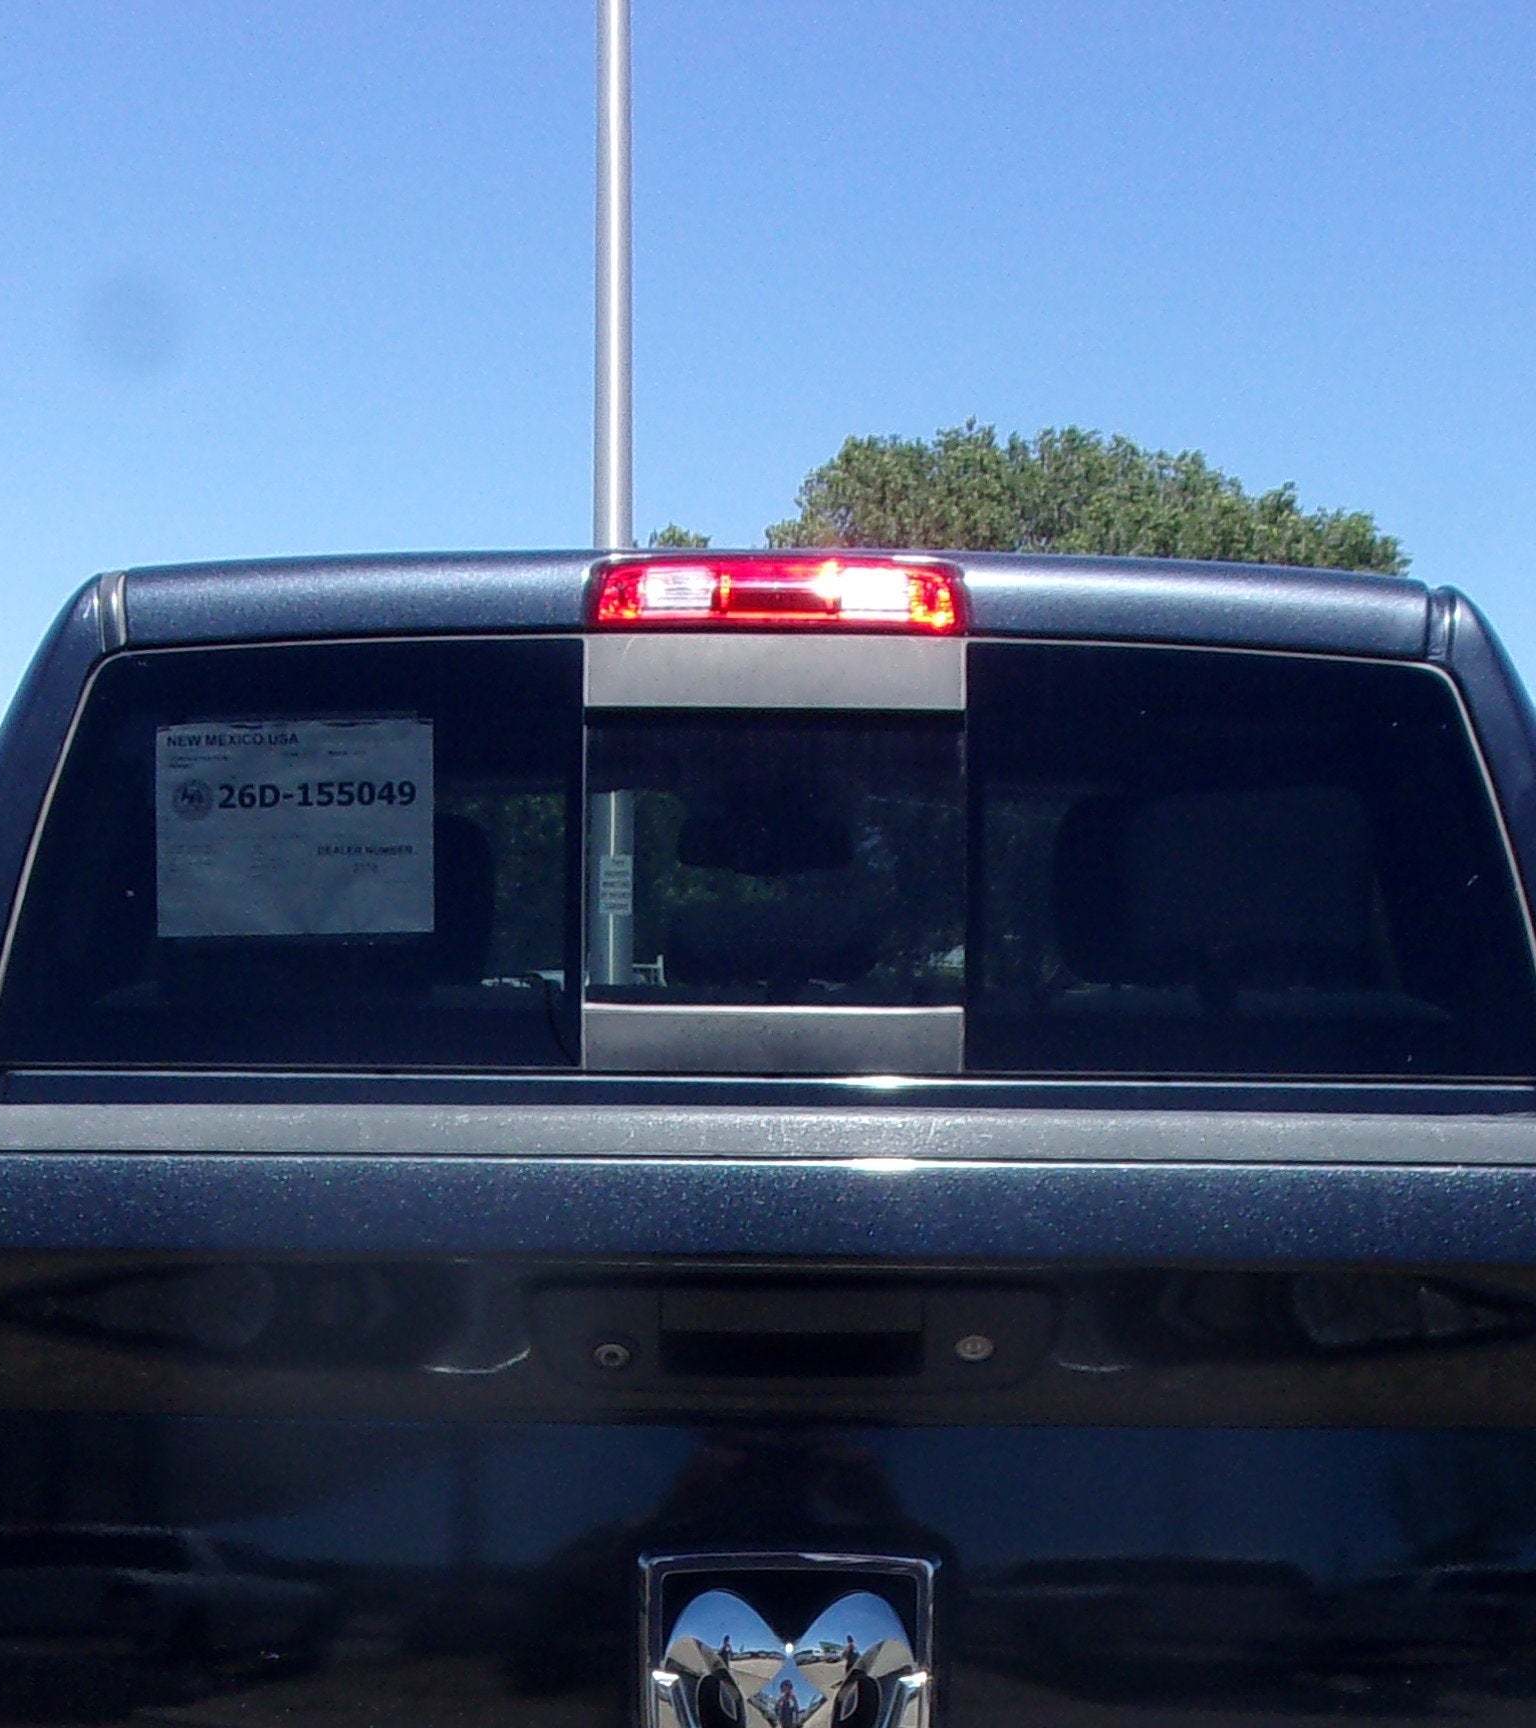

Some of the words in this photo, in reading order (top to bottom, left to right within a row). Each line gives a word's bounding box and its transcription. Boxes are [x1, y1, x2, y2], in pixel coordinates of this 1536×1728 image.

[166, 735, 202, 748] NEW
[205, 733, 264, 747] MEXICO
[267, 732, 300, 746] USA
[217, 780, 417, 810] 26D-155049
